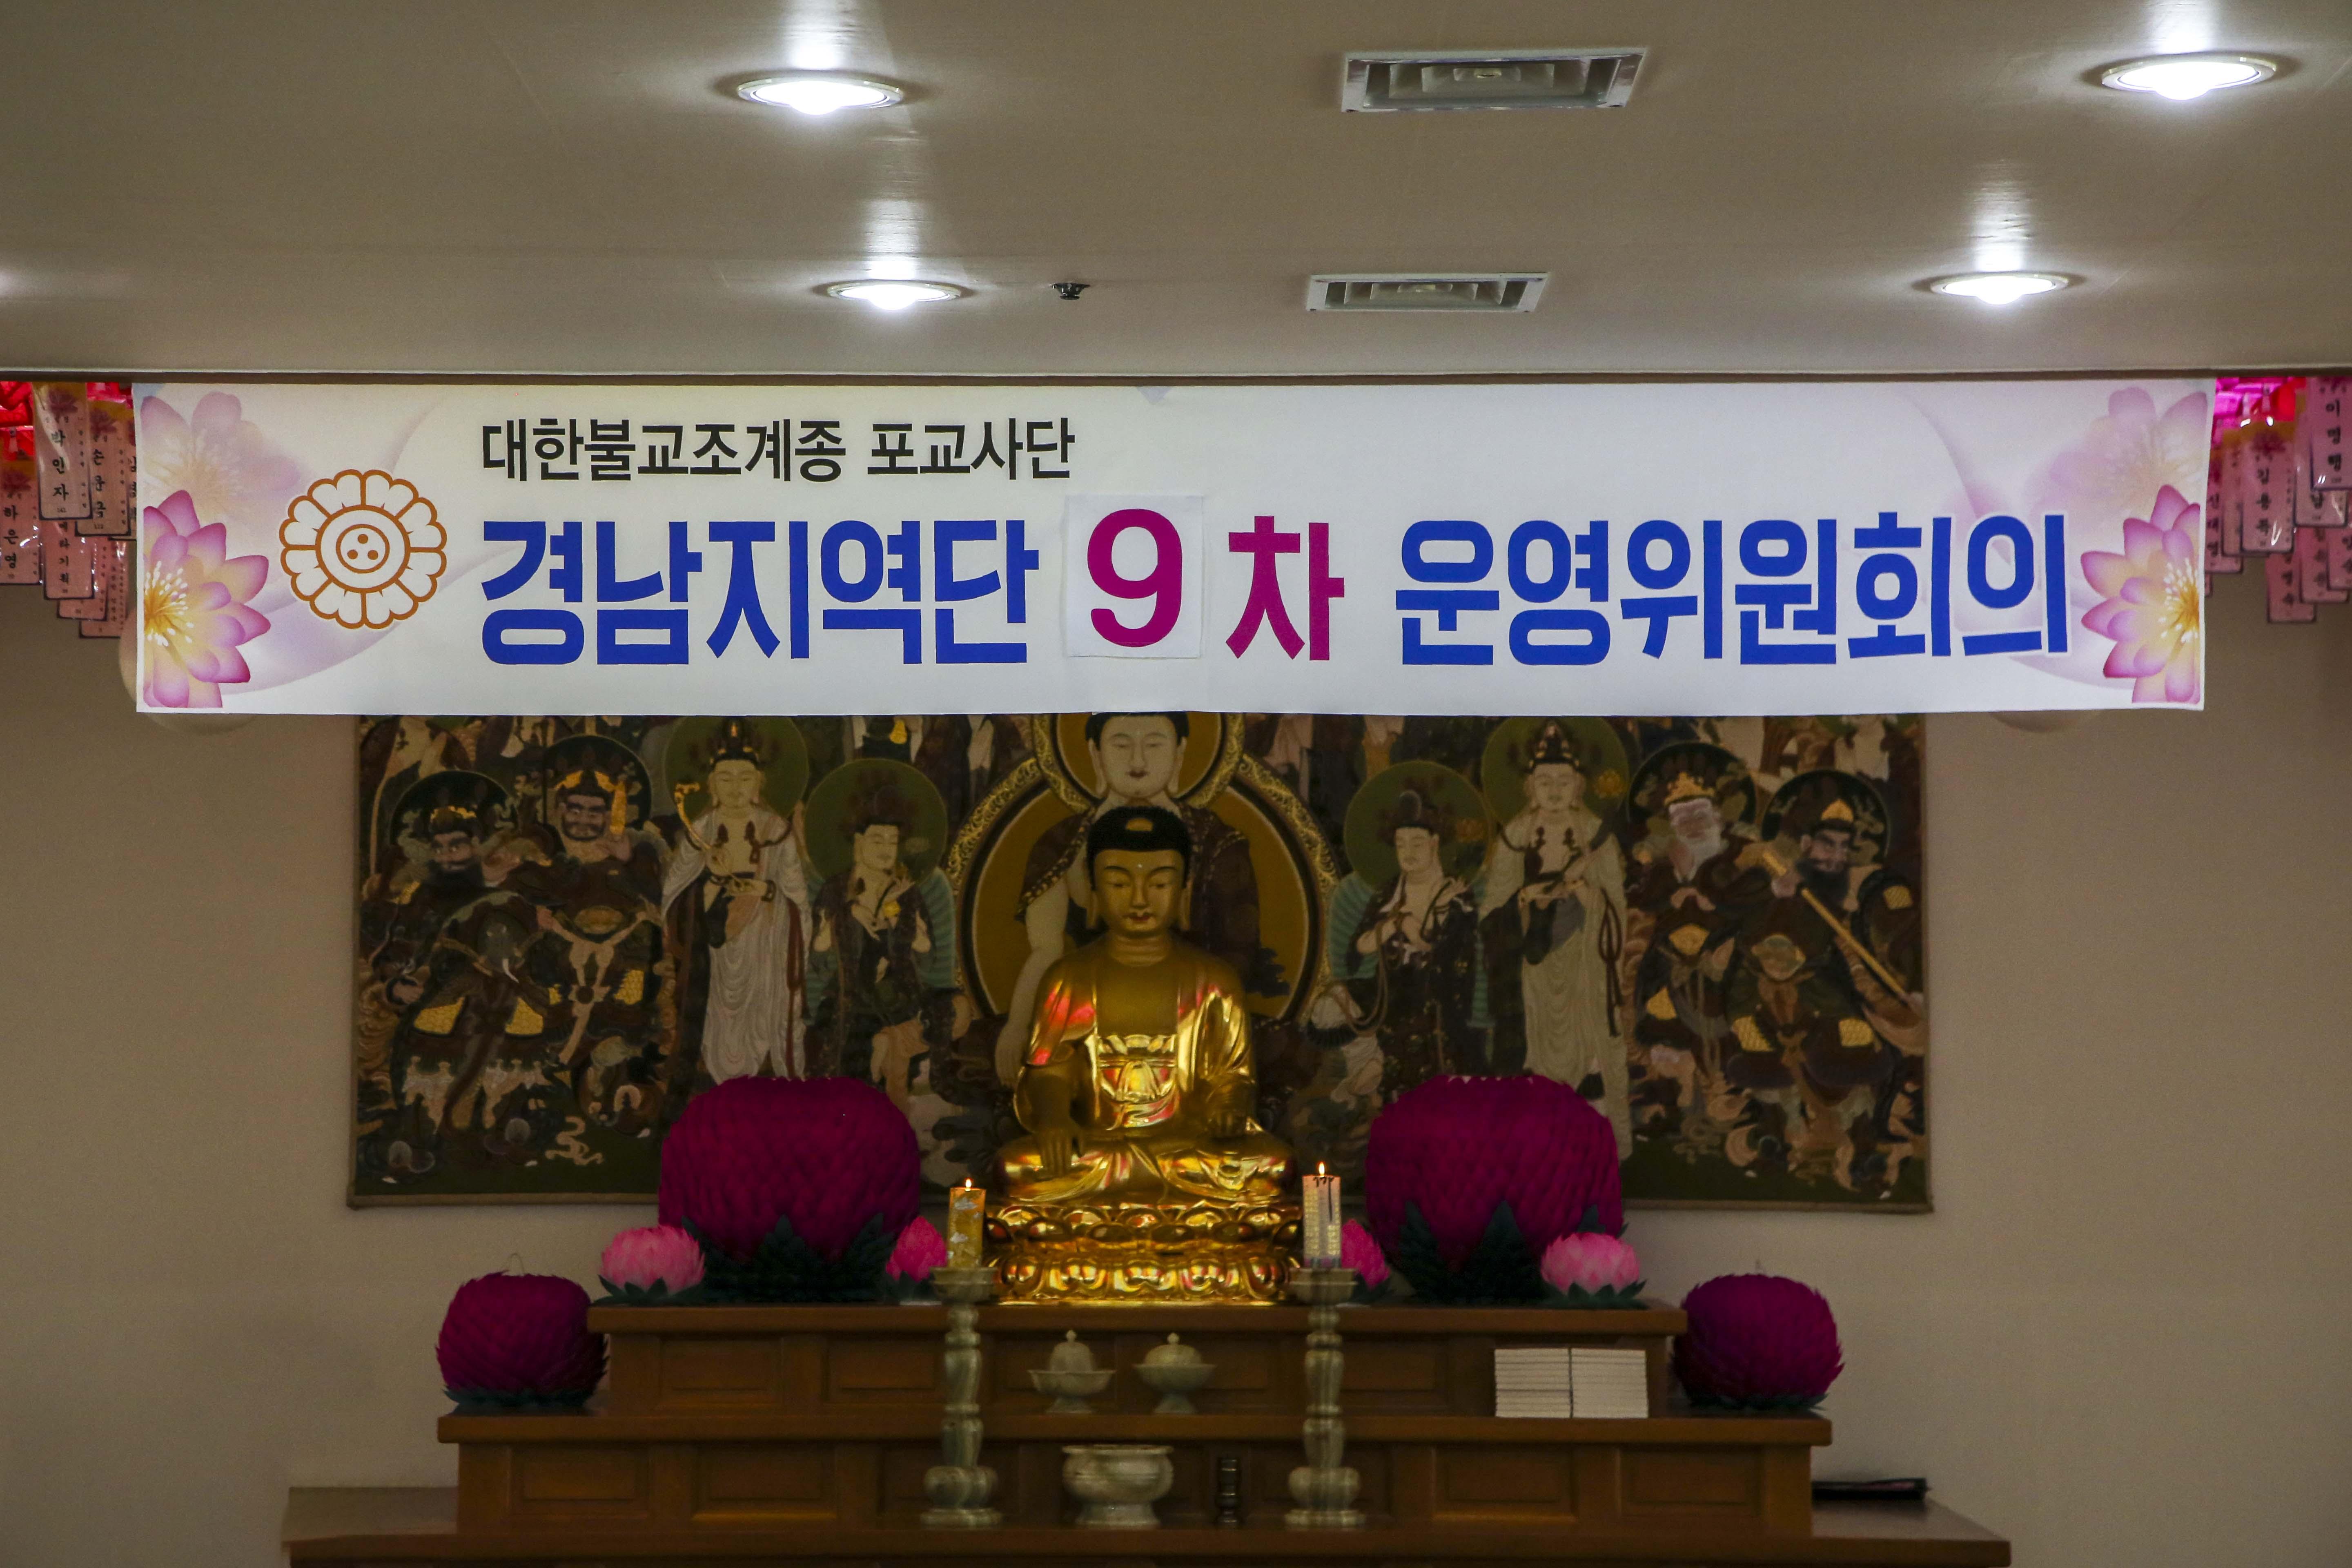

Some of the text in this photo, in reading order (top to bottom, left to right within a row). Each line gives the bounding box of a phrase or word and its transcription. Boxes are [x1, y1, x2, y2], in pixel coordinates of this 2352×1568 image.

[483, 417, 1076, 482] 대한불교조계종 포교사단
[481, 520, 1039, 665] 경남지역단
[1087, 509, 1183, 648] 9
[1226, 516, 1345, 661] 차
[1396, 512, 2067, 666] 운영위원회의
